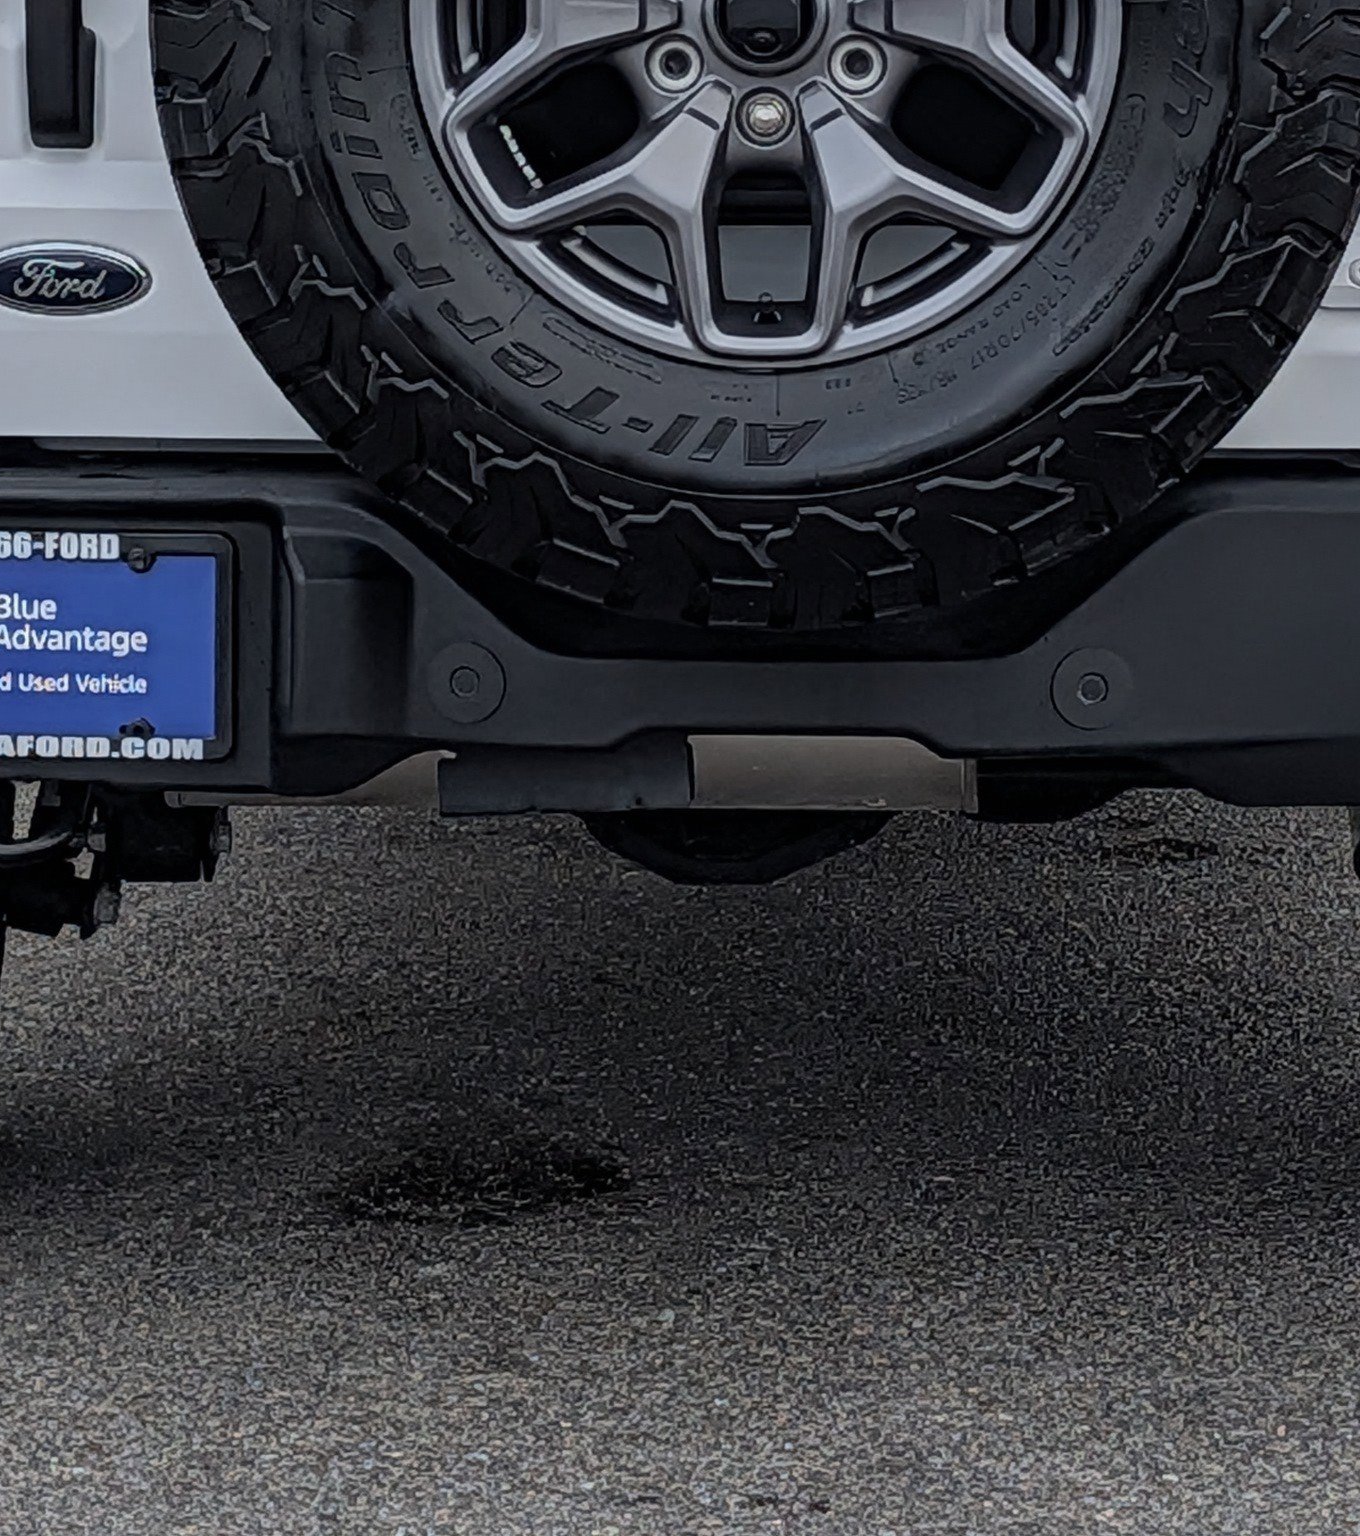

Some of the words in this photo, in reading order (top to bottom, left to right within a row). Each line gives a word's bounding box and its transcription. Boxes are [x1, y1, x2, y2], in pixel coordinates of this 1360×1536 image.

[13, 258, 108, 299] Ford
[326, 51, 828, 466] All-Terrain
[18, 672, 69, 692] Used
[75, 673, 147, 694] Vehicle
